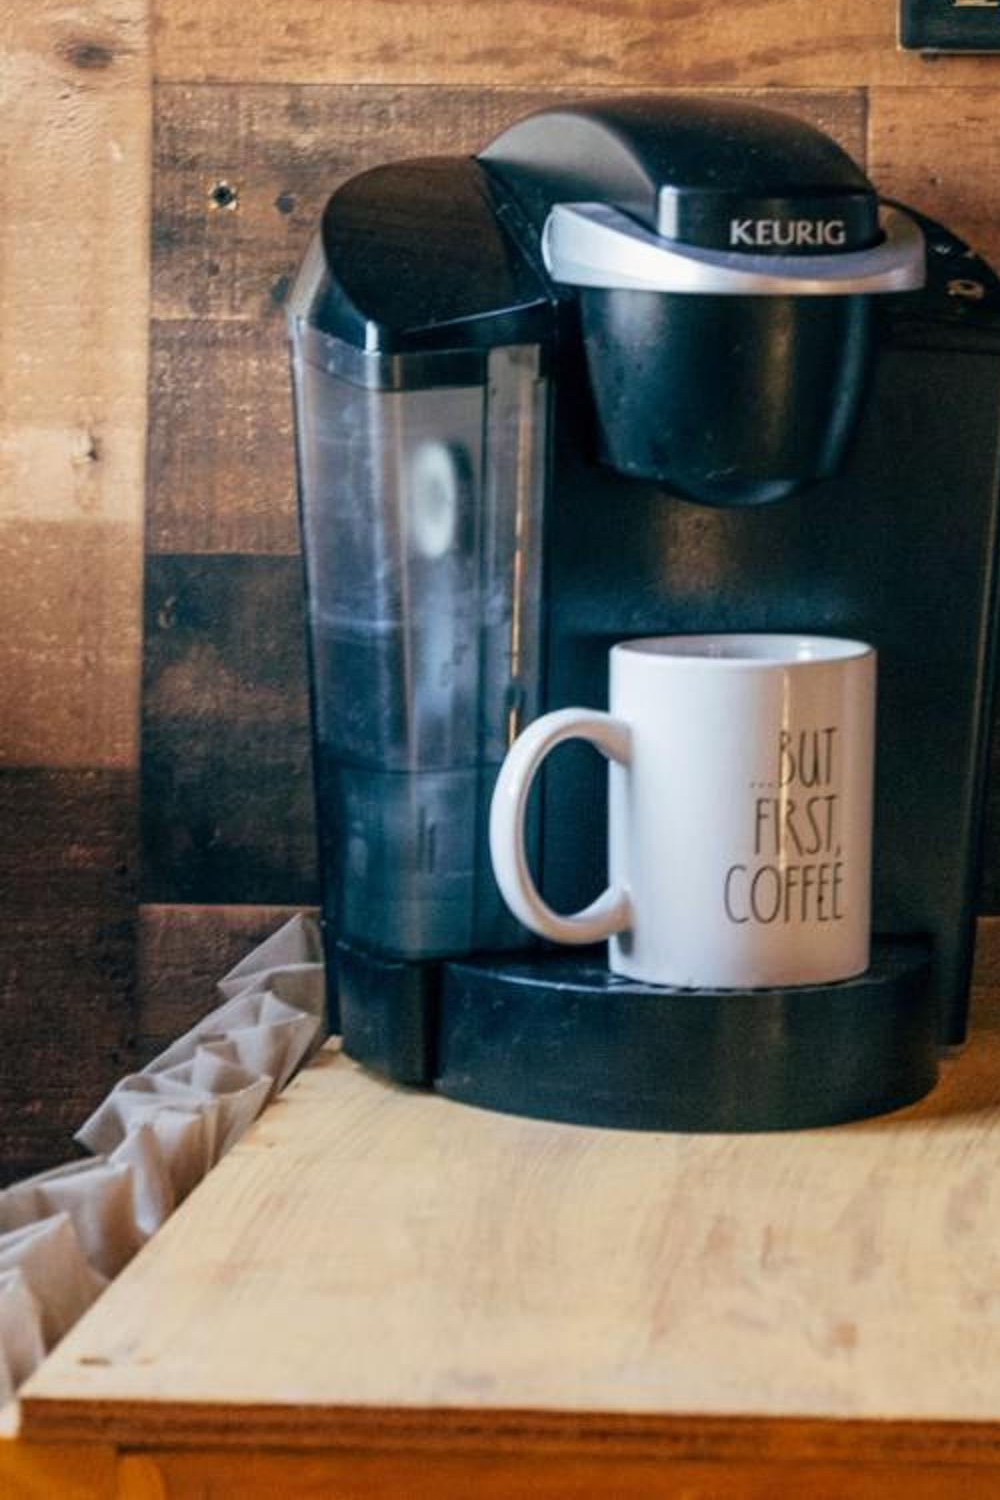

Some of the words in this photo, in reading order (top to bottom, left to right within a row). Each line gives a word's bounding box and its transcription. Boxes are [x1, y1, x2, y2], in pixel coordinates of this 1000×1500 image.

[730, 220, 846, 245] KEURIG
[755, 795, 841, 857] FIRST,
[724, 861, 844, 925] COFFEE
